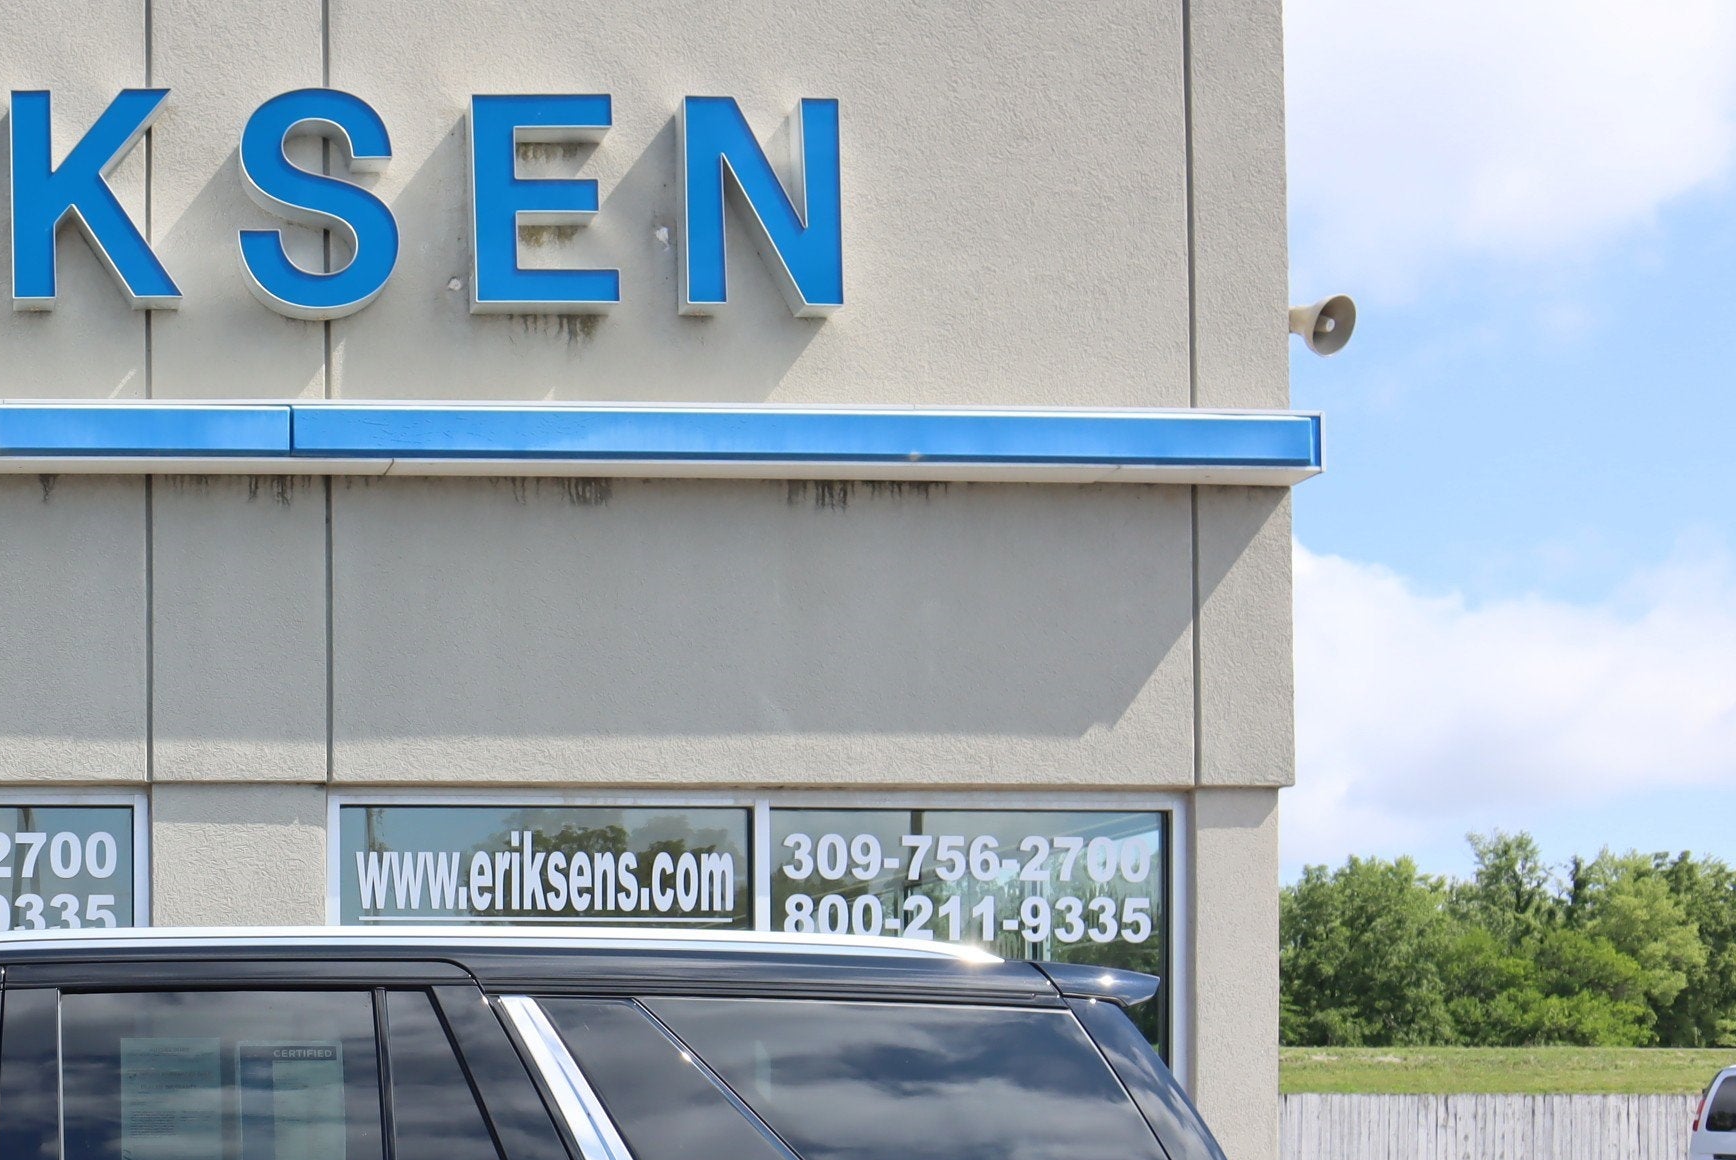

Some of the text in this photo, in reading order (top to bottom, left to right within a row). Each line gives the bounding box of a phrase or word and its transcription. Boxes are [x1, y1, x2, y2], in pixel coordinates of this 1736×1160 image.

[354, 830, 734, 913] www.eriksens.com
[782, 832, 1152, 883] 309-756-2700
[783, 893, 1153, 944] 800-211-9335
[273, 1048, 333, 1058] CERTIFIED
